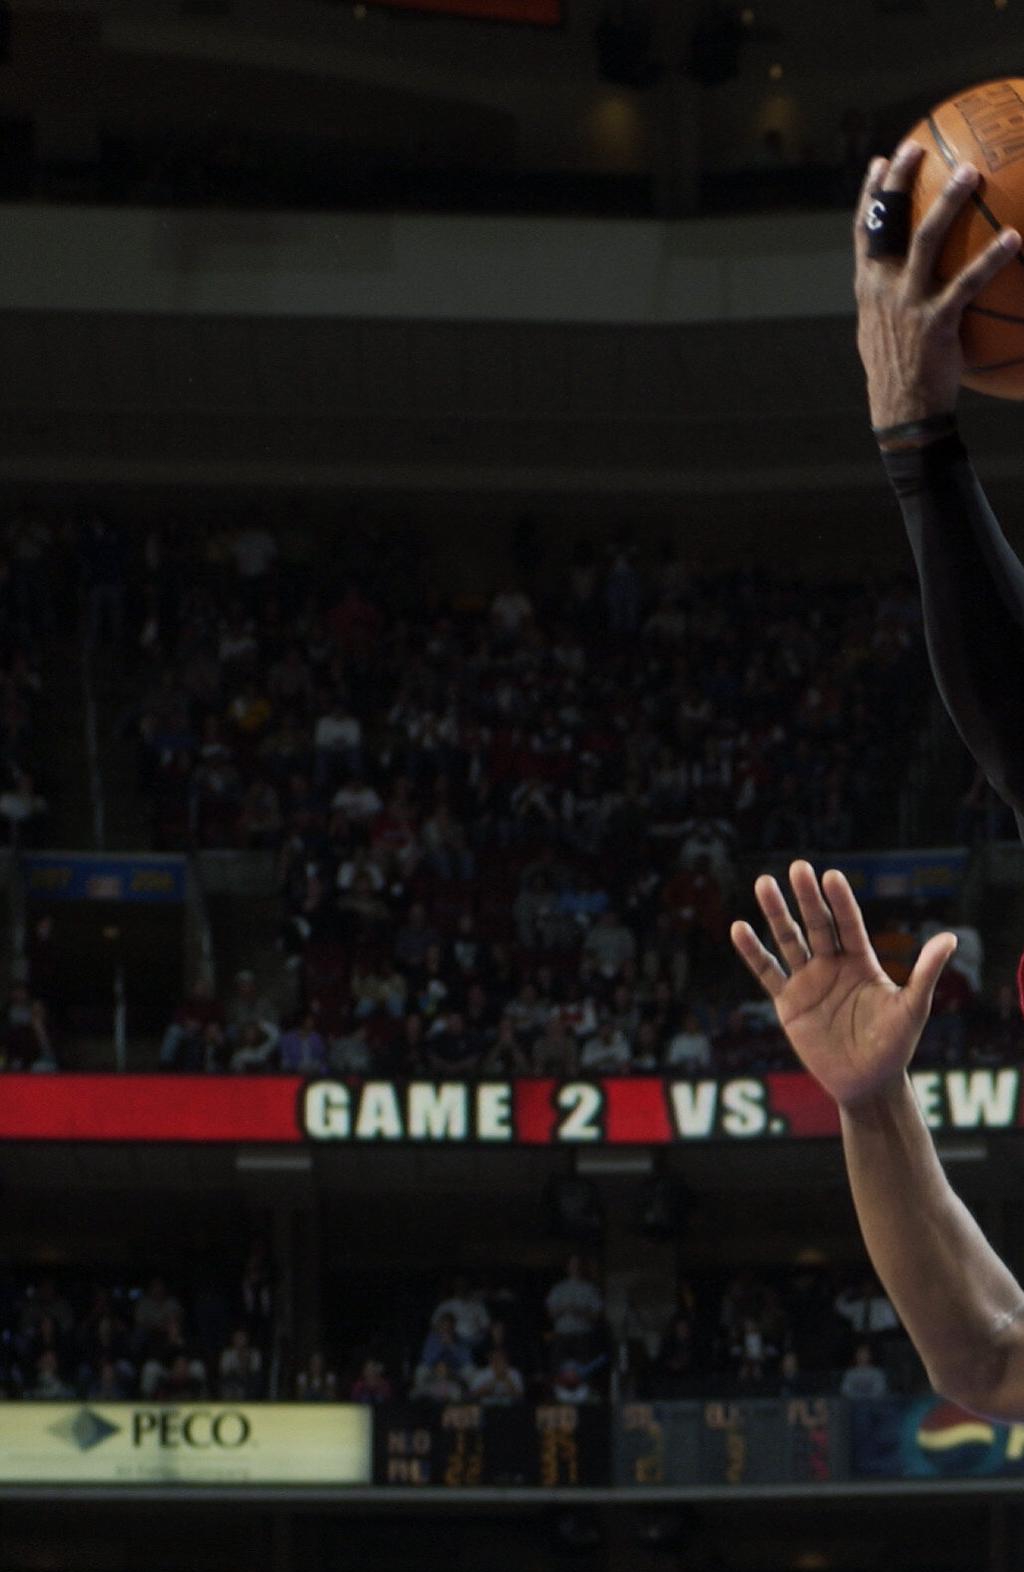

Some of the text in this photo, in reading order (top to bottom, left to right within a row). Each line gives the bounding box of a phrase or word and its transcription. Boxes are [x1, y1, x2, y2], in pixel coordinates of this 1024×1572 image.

[303, 1080, 513, 1140] GAME
[556, 1083, 601, 1141] 2
[670, 1079, 786, 1139] VS.
[911, 1069, 1019, 1128] EW
[131, 1410, 252, 1449] PECO
